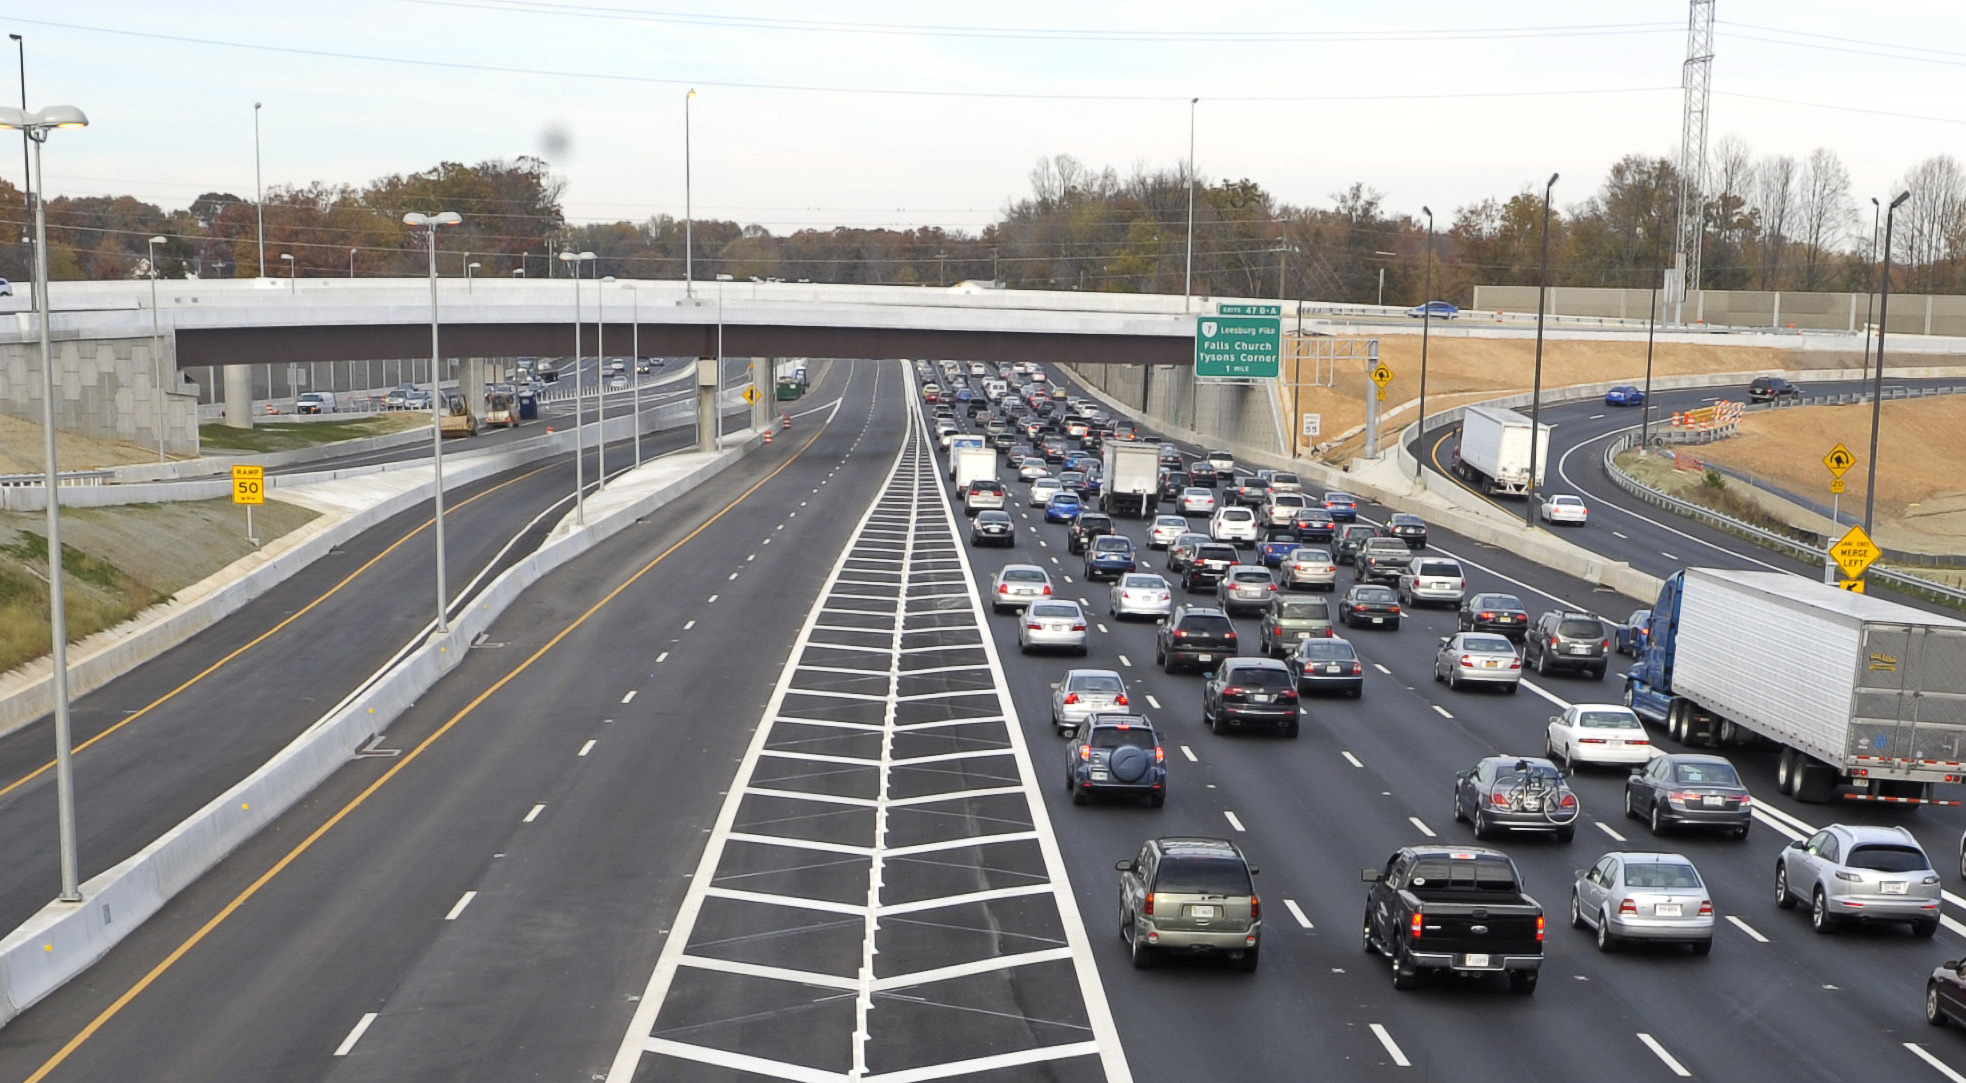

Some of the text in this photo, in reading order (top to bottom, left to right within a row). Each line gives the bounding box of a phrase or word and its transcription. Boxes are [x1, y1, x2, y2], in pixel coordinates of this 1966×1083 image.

[1208, 326, 1212, 334] 7
[1221, 326, 1256, 336] Leesburg
[1204, 341, 1272, 350] Falls Church
[1200, 353, 1276, 363] Tysons Corner
[239, 482, 258, 493] 50
